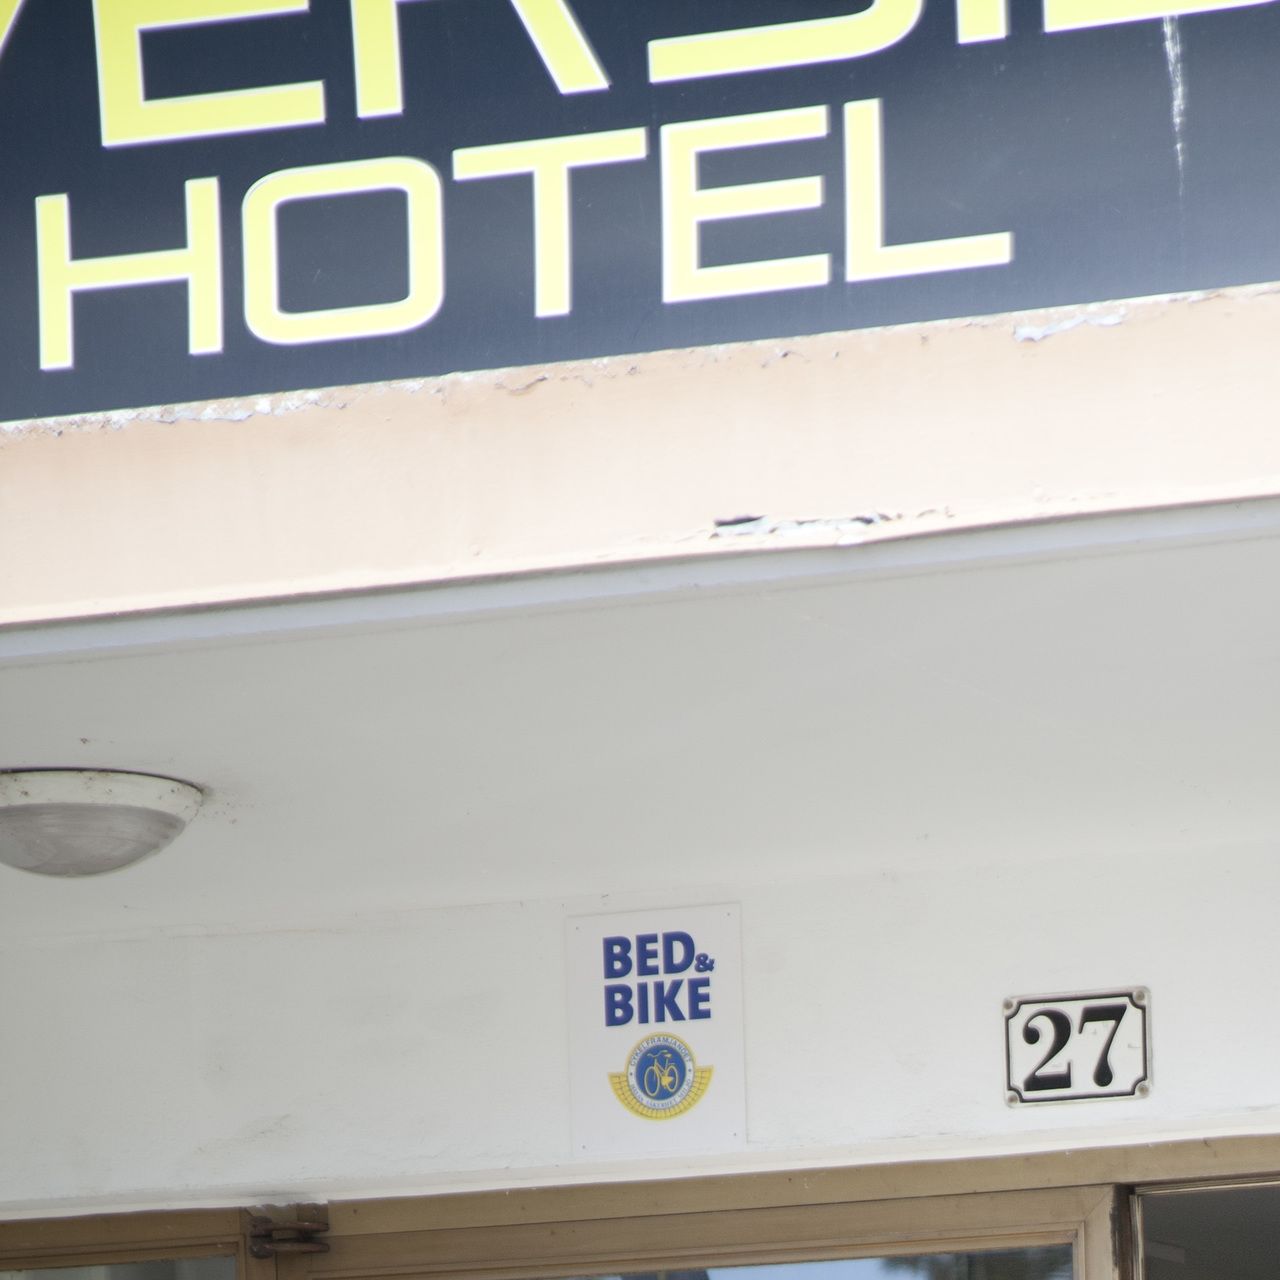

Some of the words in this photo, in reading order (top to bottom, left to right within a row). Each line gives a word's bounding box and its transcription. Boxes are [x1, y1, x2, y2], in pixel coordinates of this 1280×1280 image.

[36, 98, 1014, 371] HOTEL
[604, 976, 711, 1027] BIKE
[1022, 1003, 1127, 1091] 27
